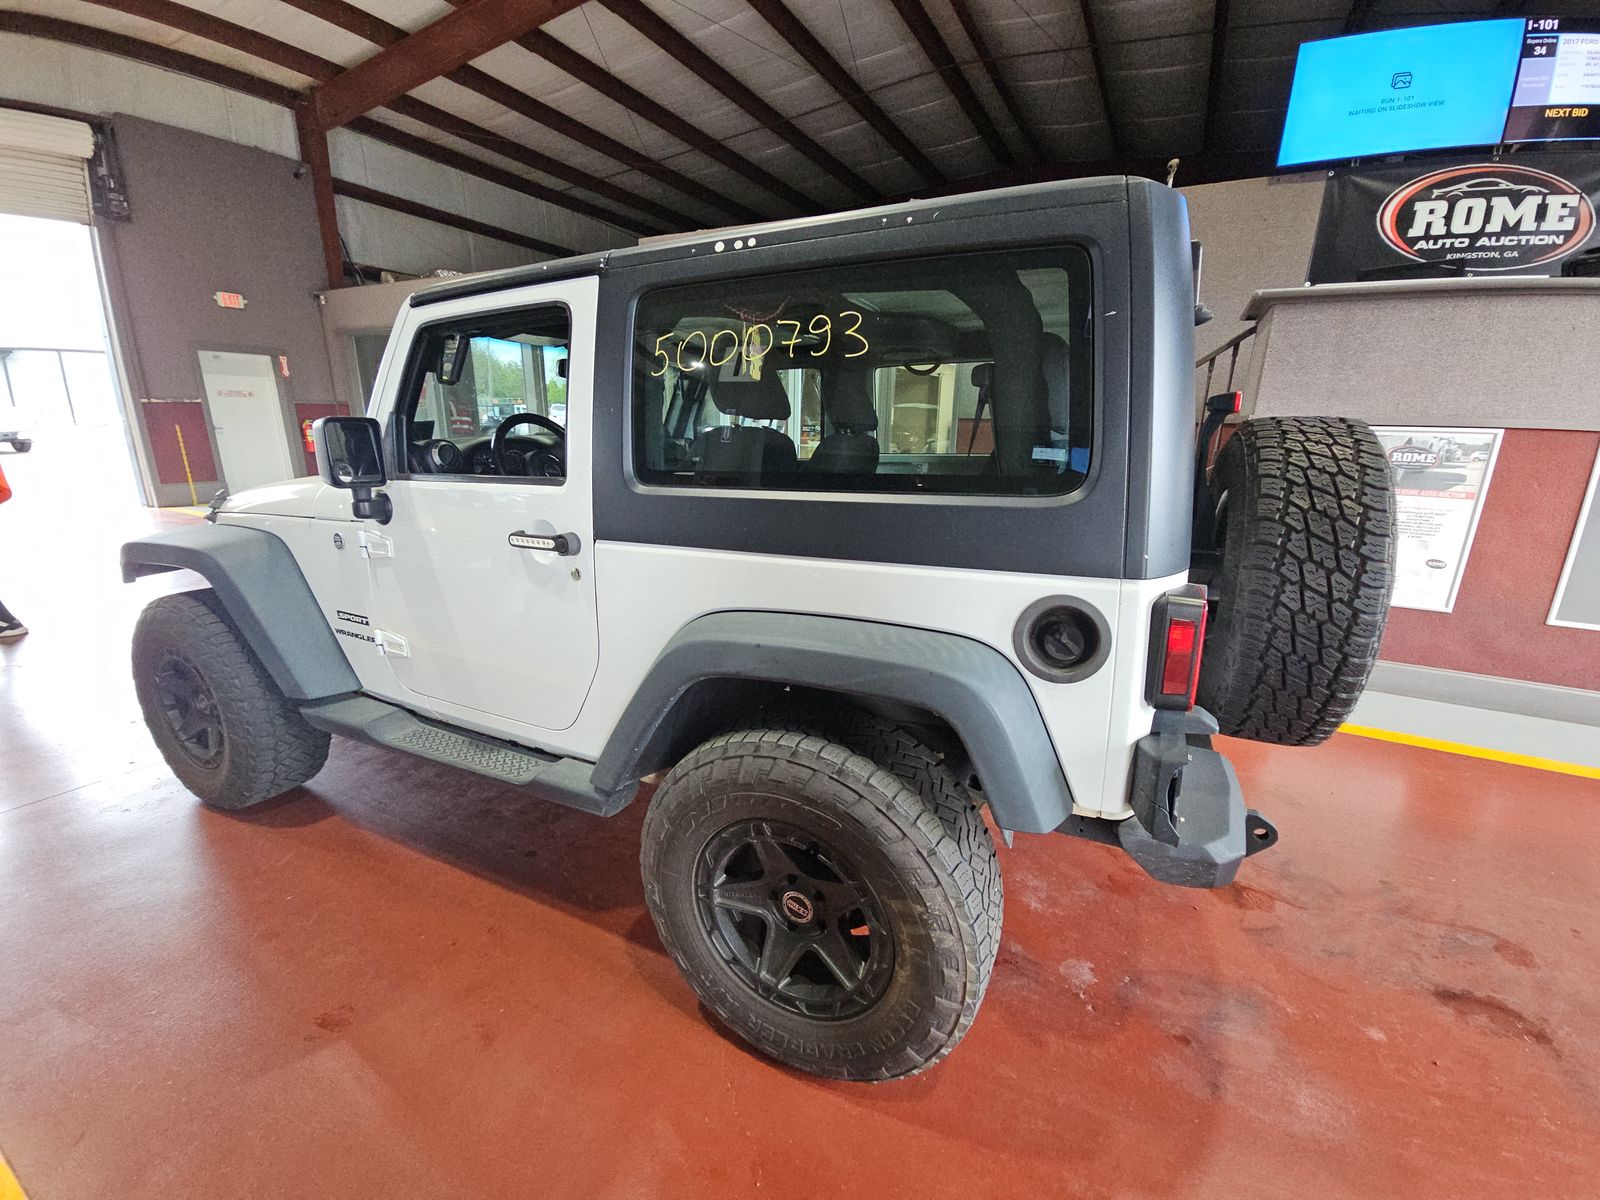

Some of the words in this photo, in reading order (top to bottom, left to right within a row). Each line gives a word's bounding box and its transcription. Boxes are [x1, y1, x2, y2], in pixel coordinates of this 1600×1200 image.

[1533, 45, 1547, 55] 34
[1348, 107, 1376, 116] WAITING
[1388, 102, 1426, 111] SLIDESHOW
[1545, 108, 1571, 118] NEXT
[1571, 107, 1589, 117] BID
[1407, 194, 1580, 237] ROME
[1413, 237, 1470, 250] AUTO
[1475, 234, 1565, 248] AUCTION
[1446, 251, 1502, 260] KINGSTON,
[651, 311, 869, 376] 5000793
[1391, 452, 1437, 463] ROME
[338, 612, 368, 624] SPORT
